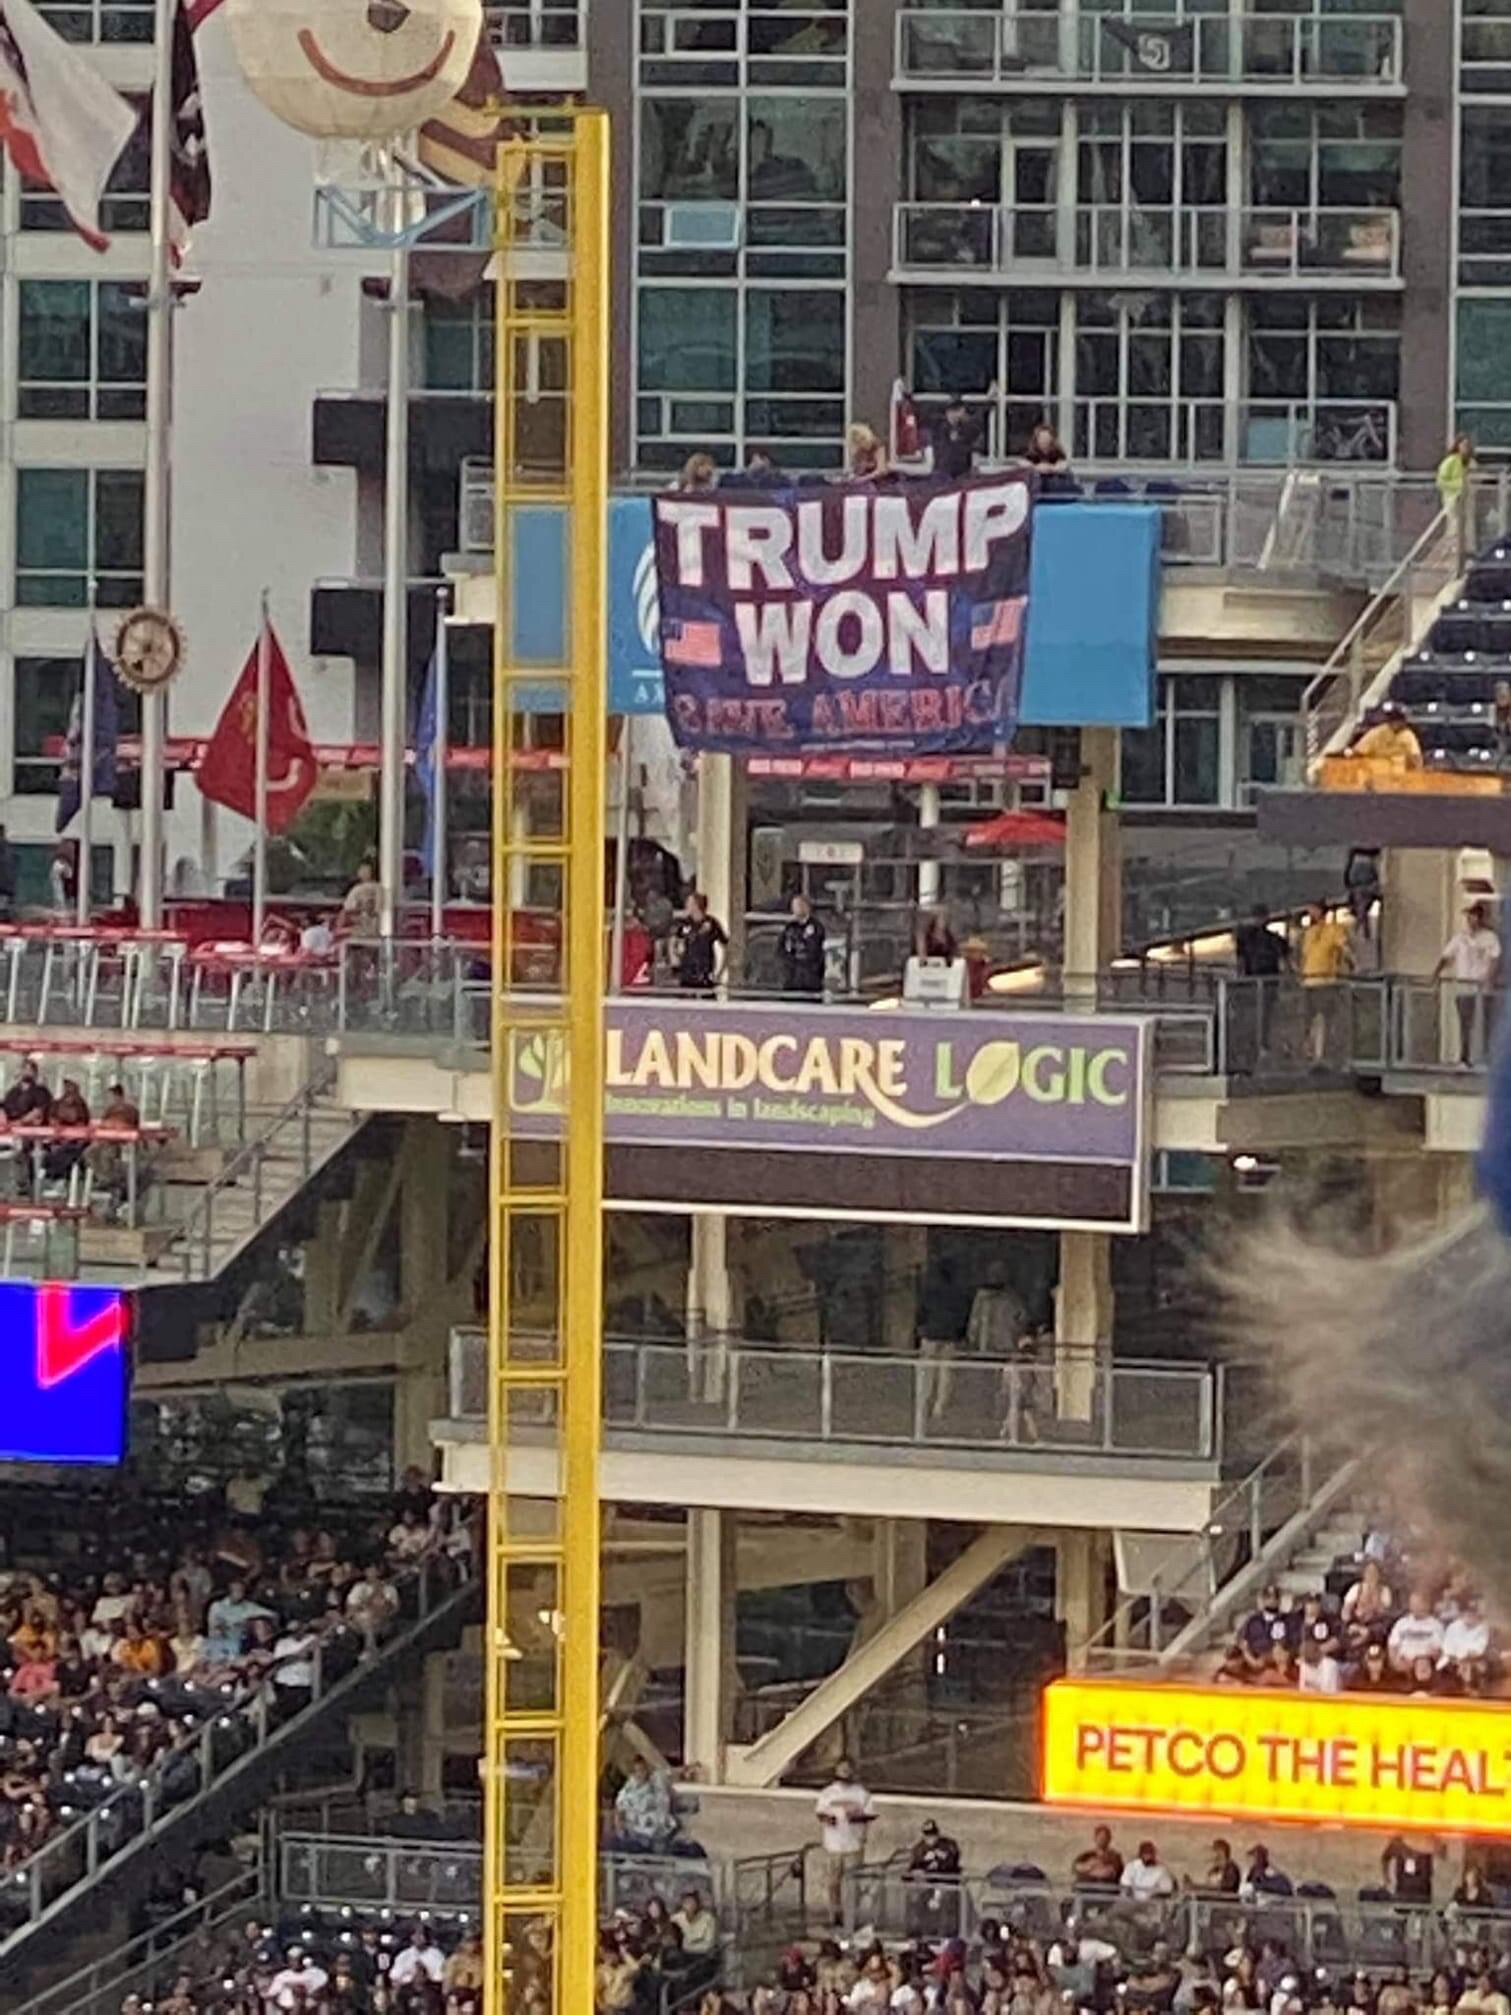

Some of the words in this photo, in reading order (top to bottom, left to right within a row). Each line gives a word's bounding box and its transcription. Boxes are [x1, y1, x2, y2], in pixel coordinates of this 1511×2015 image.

[656, 481, 1029, 591] TRUMP
[734, 590, 950, 687] WON
[605, 1029, 908, 1097] LANDCARE
[935, 1040, 1128, 1106] LOGIC
[1076, 1724, 1246, 1781] PETCO
[1257, 1735, 1358, 1787] THE
[1371, 1742, 1511, 1797] HEAL
